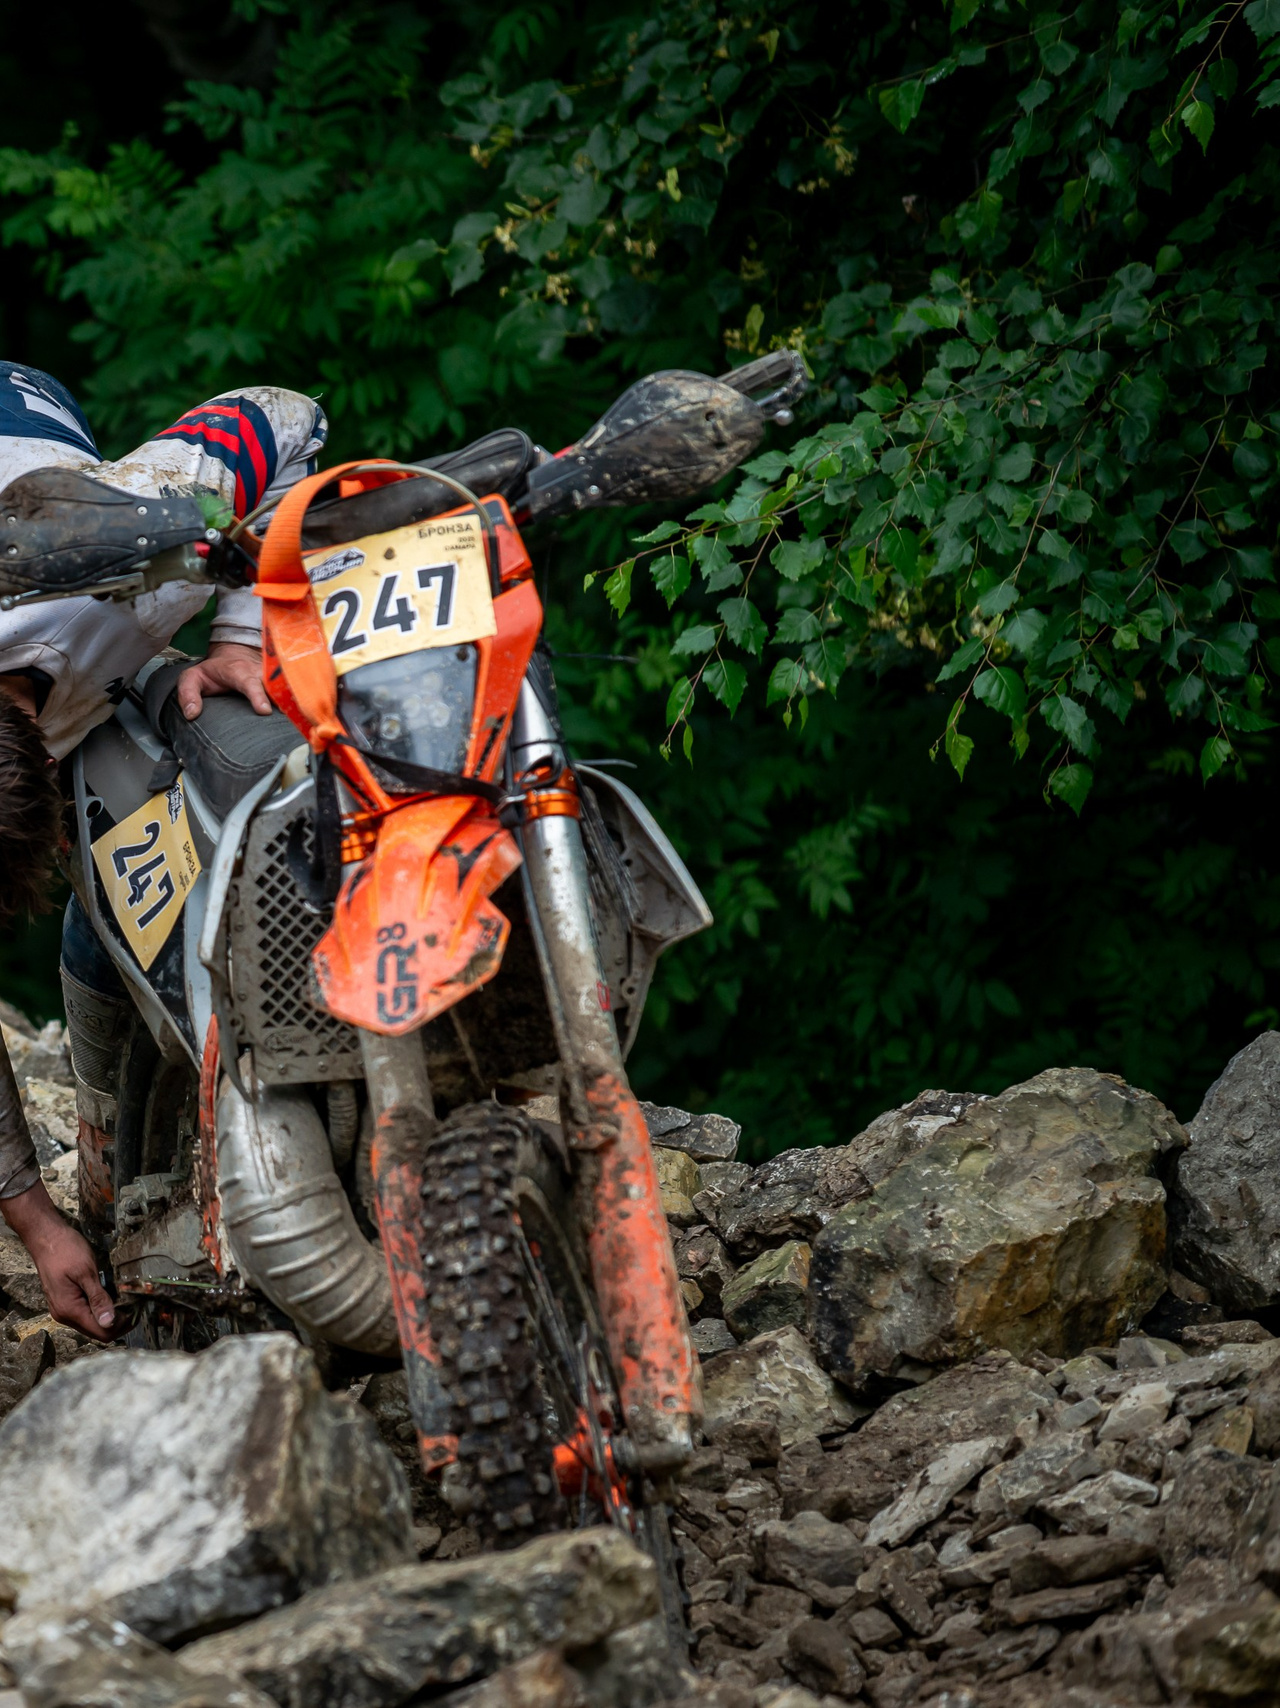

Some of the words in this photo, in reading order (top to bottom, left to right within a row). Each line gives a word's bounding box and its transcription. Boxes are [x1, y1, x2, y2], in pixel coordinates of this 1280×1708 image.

[418, 522, 474, 539] БРОНЗА
[324, 564, 456, 656] 247
[112, 821, 175, 931] 247
